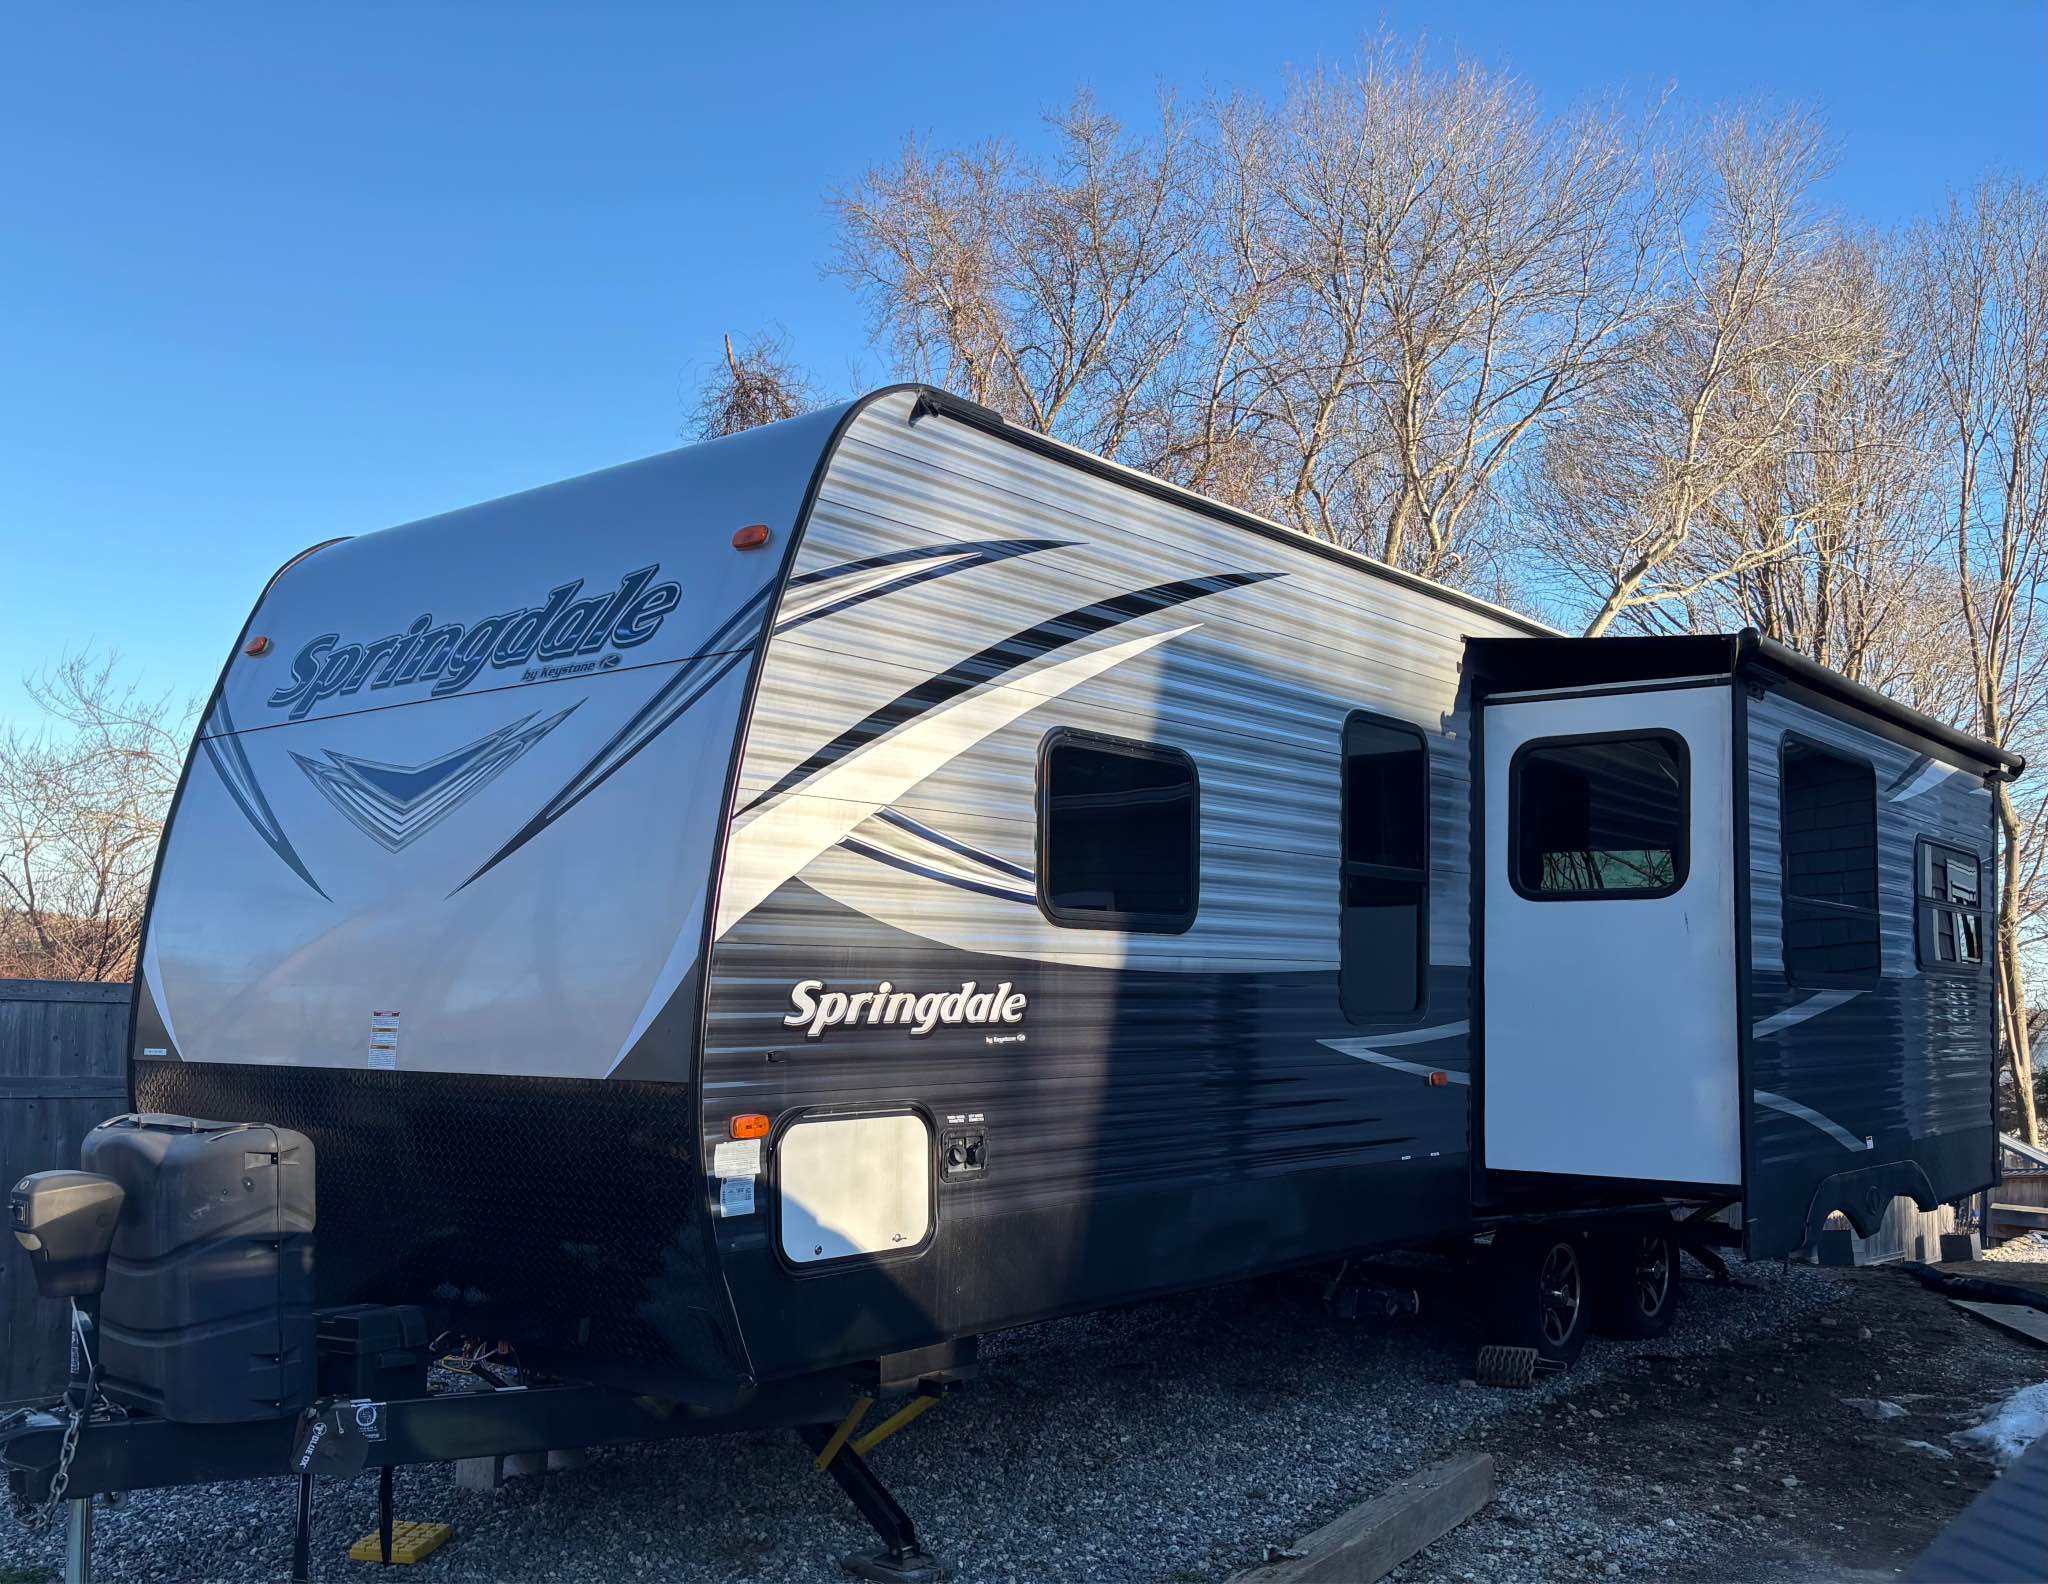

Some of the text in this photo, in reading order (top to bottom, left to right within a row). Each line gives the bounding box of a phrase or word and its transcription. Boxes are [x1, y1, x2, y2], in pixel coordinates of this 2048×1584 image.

[267, 563, 683, 720] Springdale
[521, 667, 538, 681] by
[540, 662, 596, 678] Keystone
[784, 980, 1027, 1038] Springdale
[300, 1434, 320, 1470] BLUE OX
